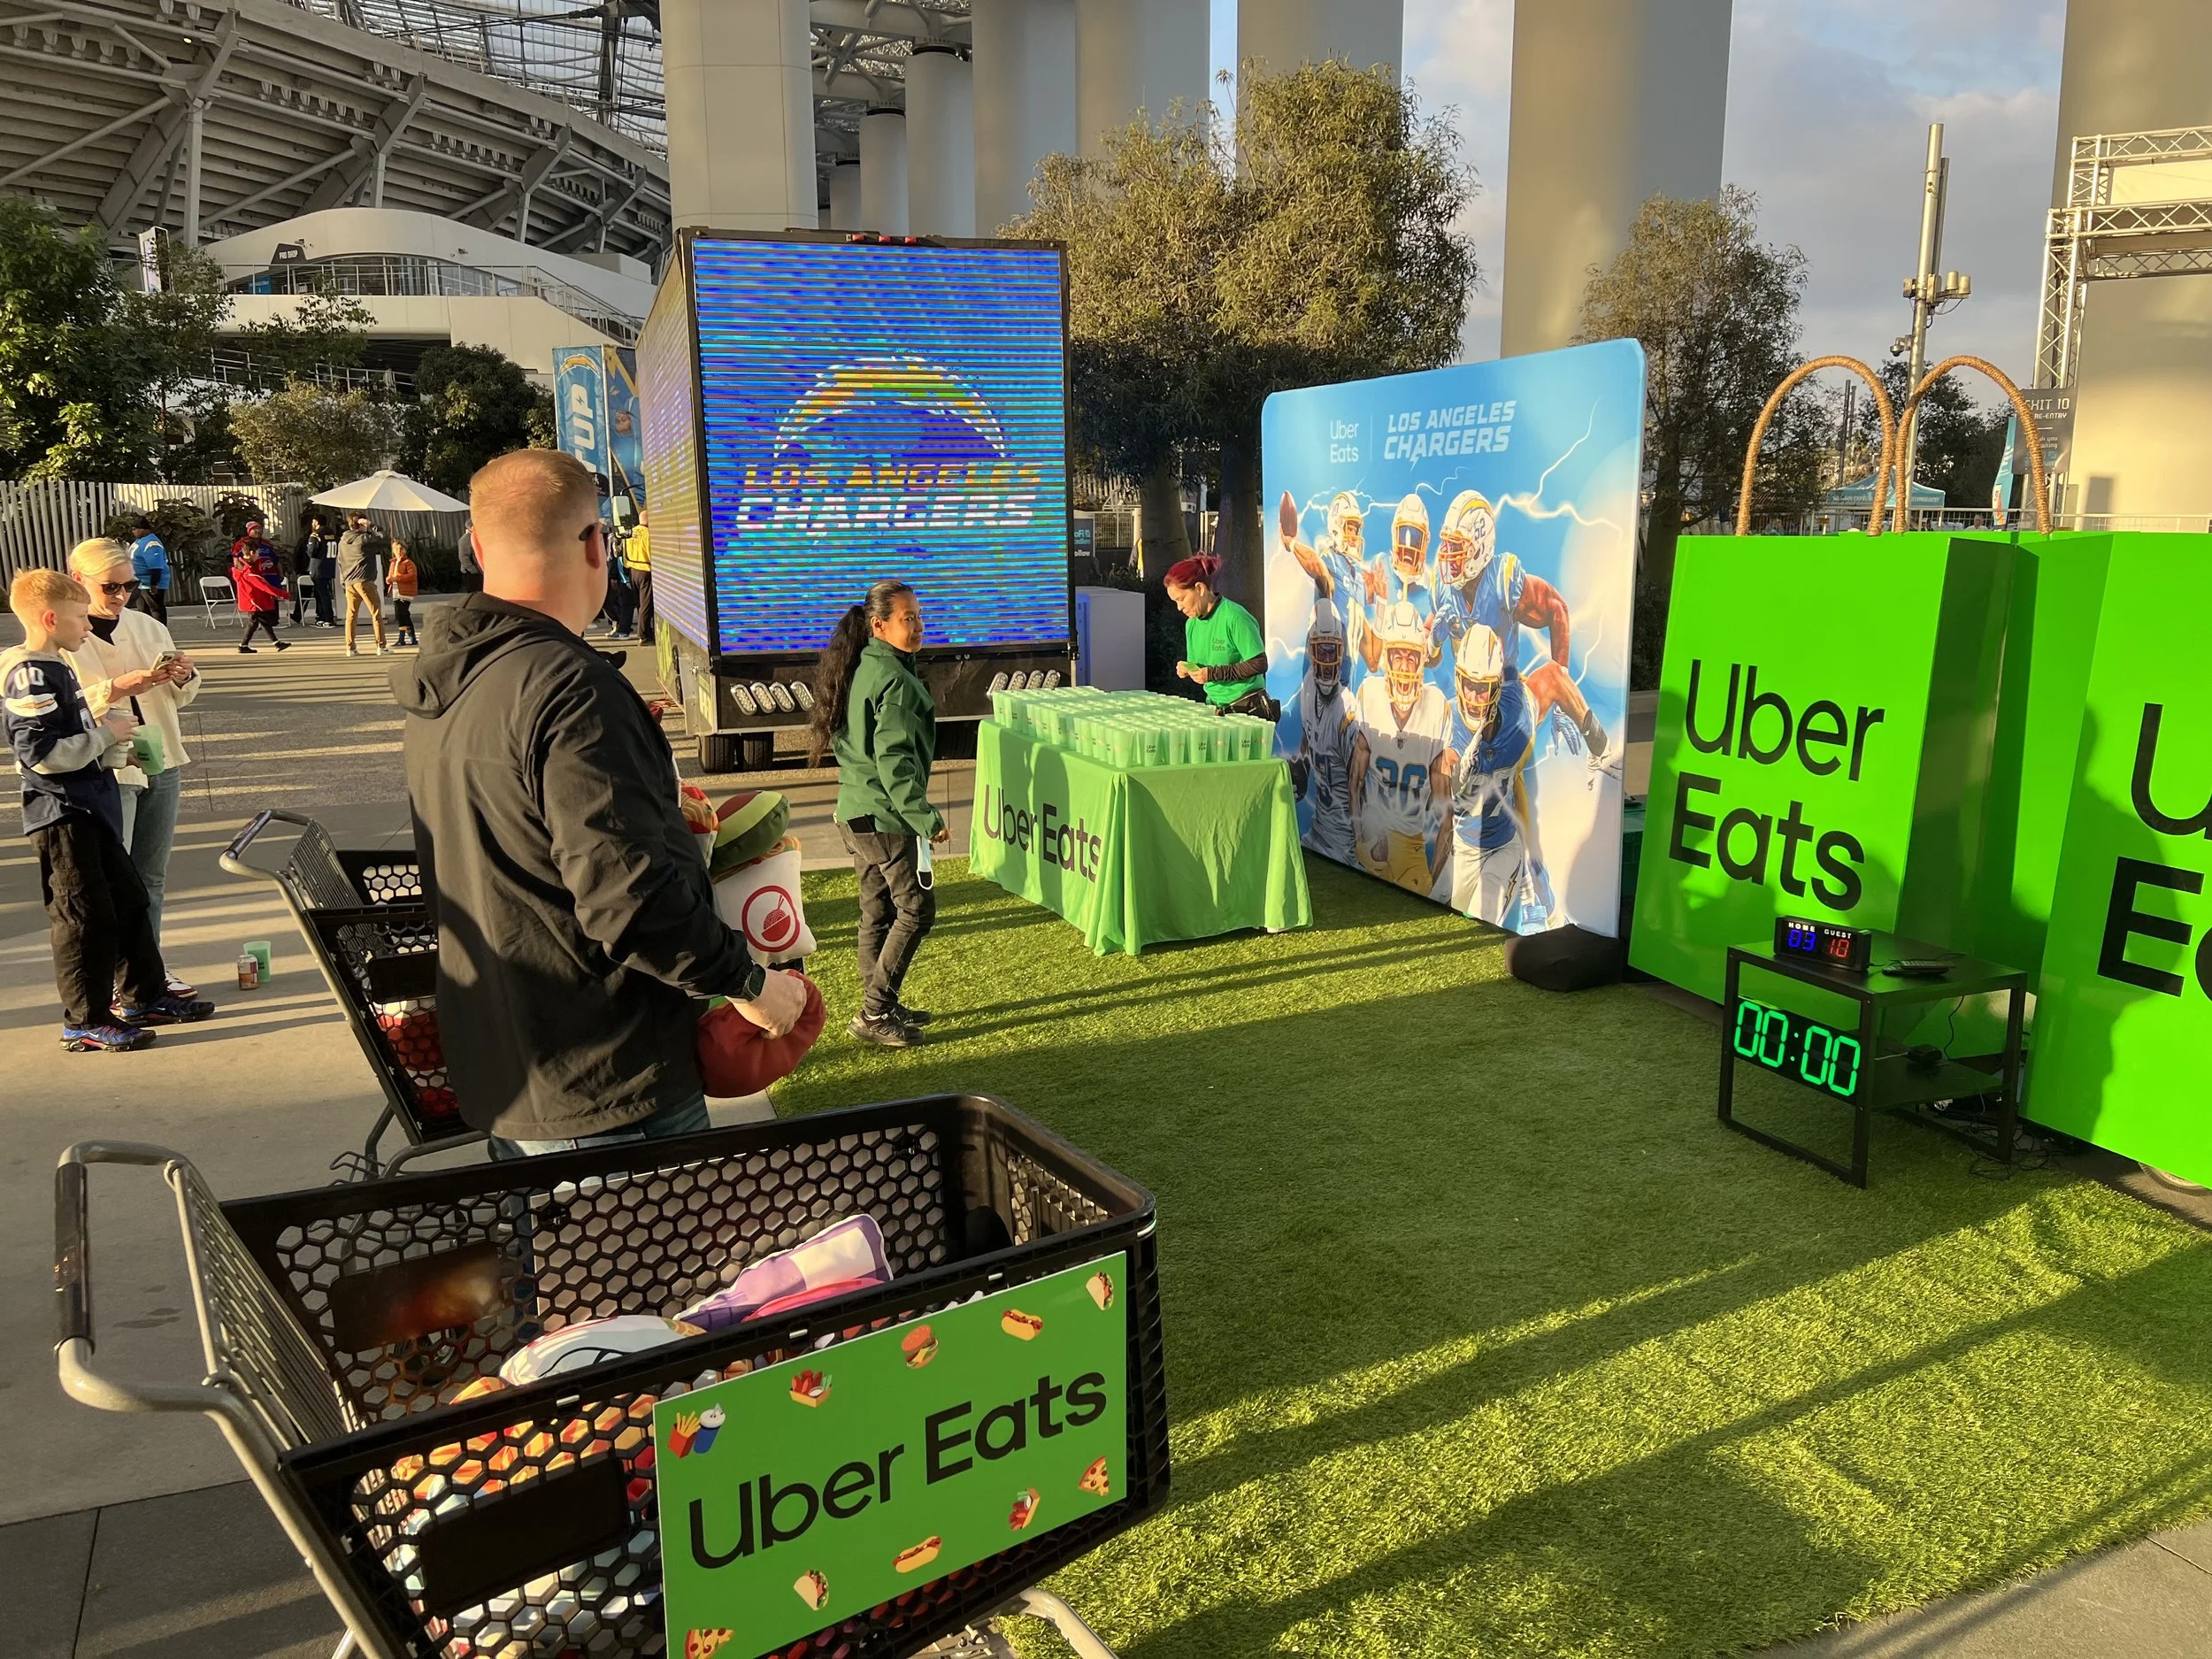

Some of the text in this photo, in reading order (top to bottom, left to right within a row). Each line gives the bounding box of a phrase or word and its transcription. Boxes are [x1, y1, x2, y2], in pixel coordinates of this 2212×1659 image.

[1387, 400, 1517, 434] LOS ANGELES
[2057, 398, 2070, 410] 10
[1330, 419, 1359, 440] Uber
[1384, 425, 1512, 462] CHARGERS
[1330, 443, 1359, 464] Eats
[1686, 658, 1886, 782] Uber
[984, 785, 1102, 883] Uber Eats
[1669, 771, 1865, 911] Eats
[1787, 929, 1816, 951] 03
[1788, 921, 1852, 939] HOME GUEST
[1734, 1002, 1860, 1096] 00:00
[688, 1372, 1107, 1570] Uber Eats
